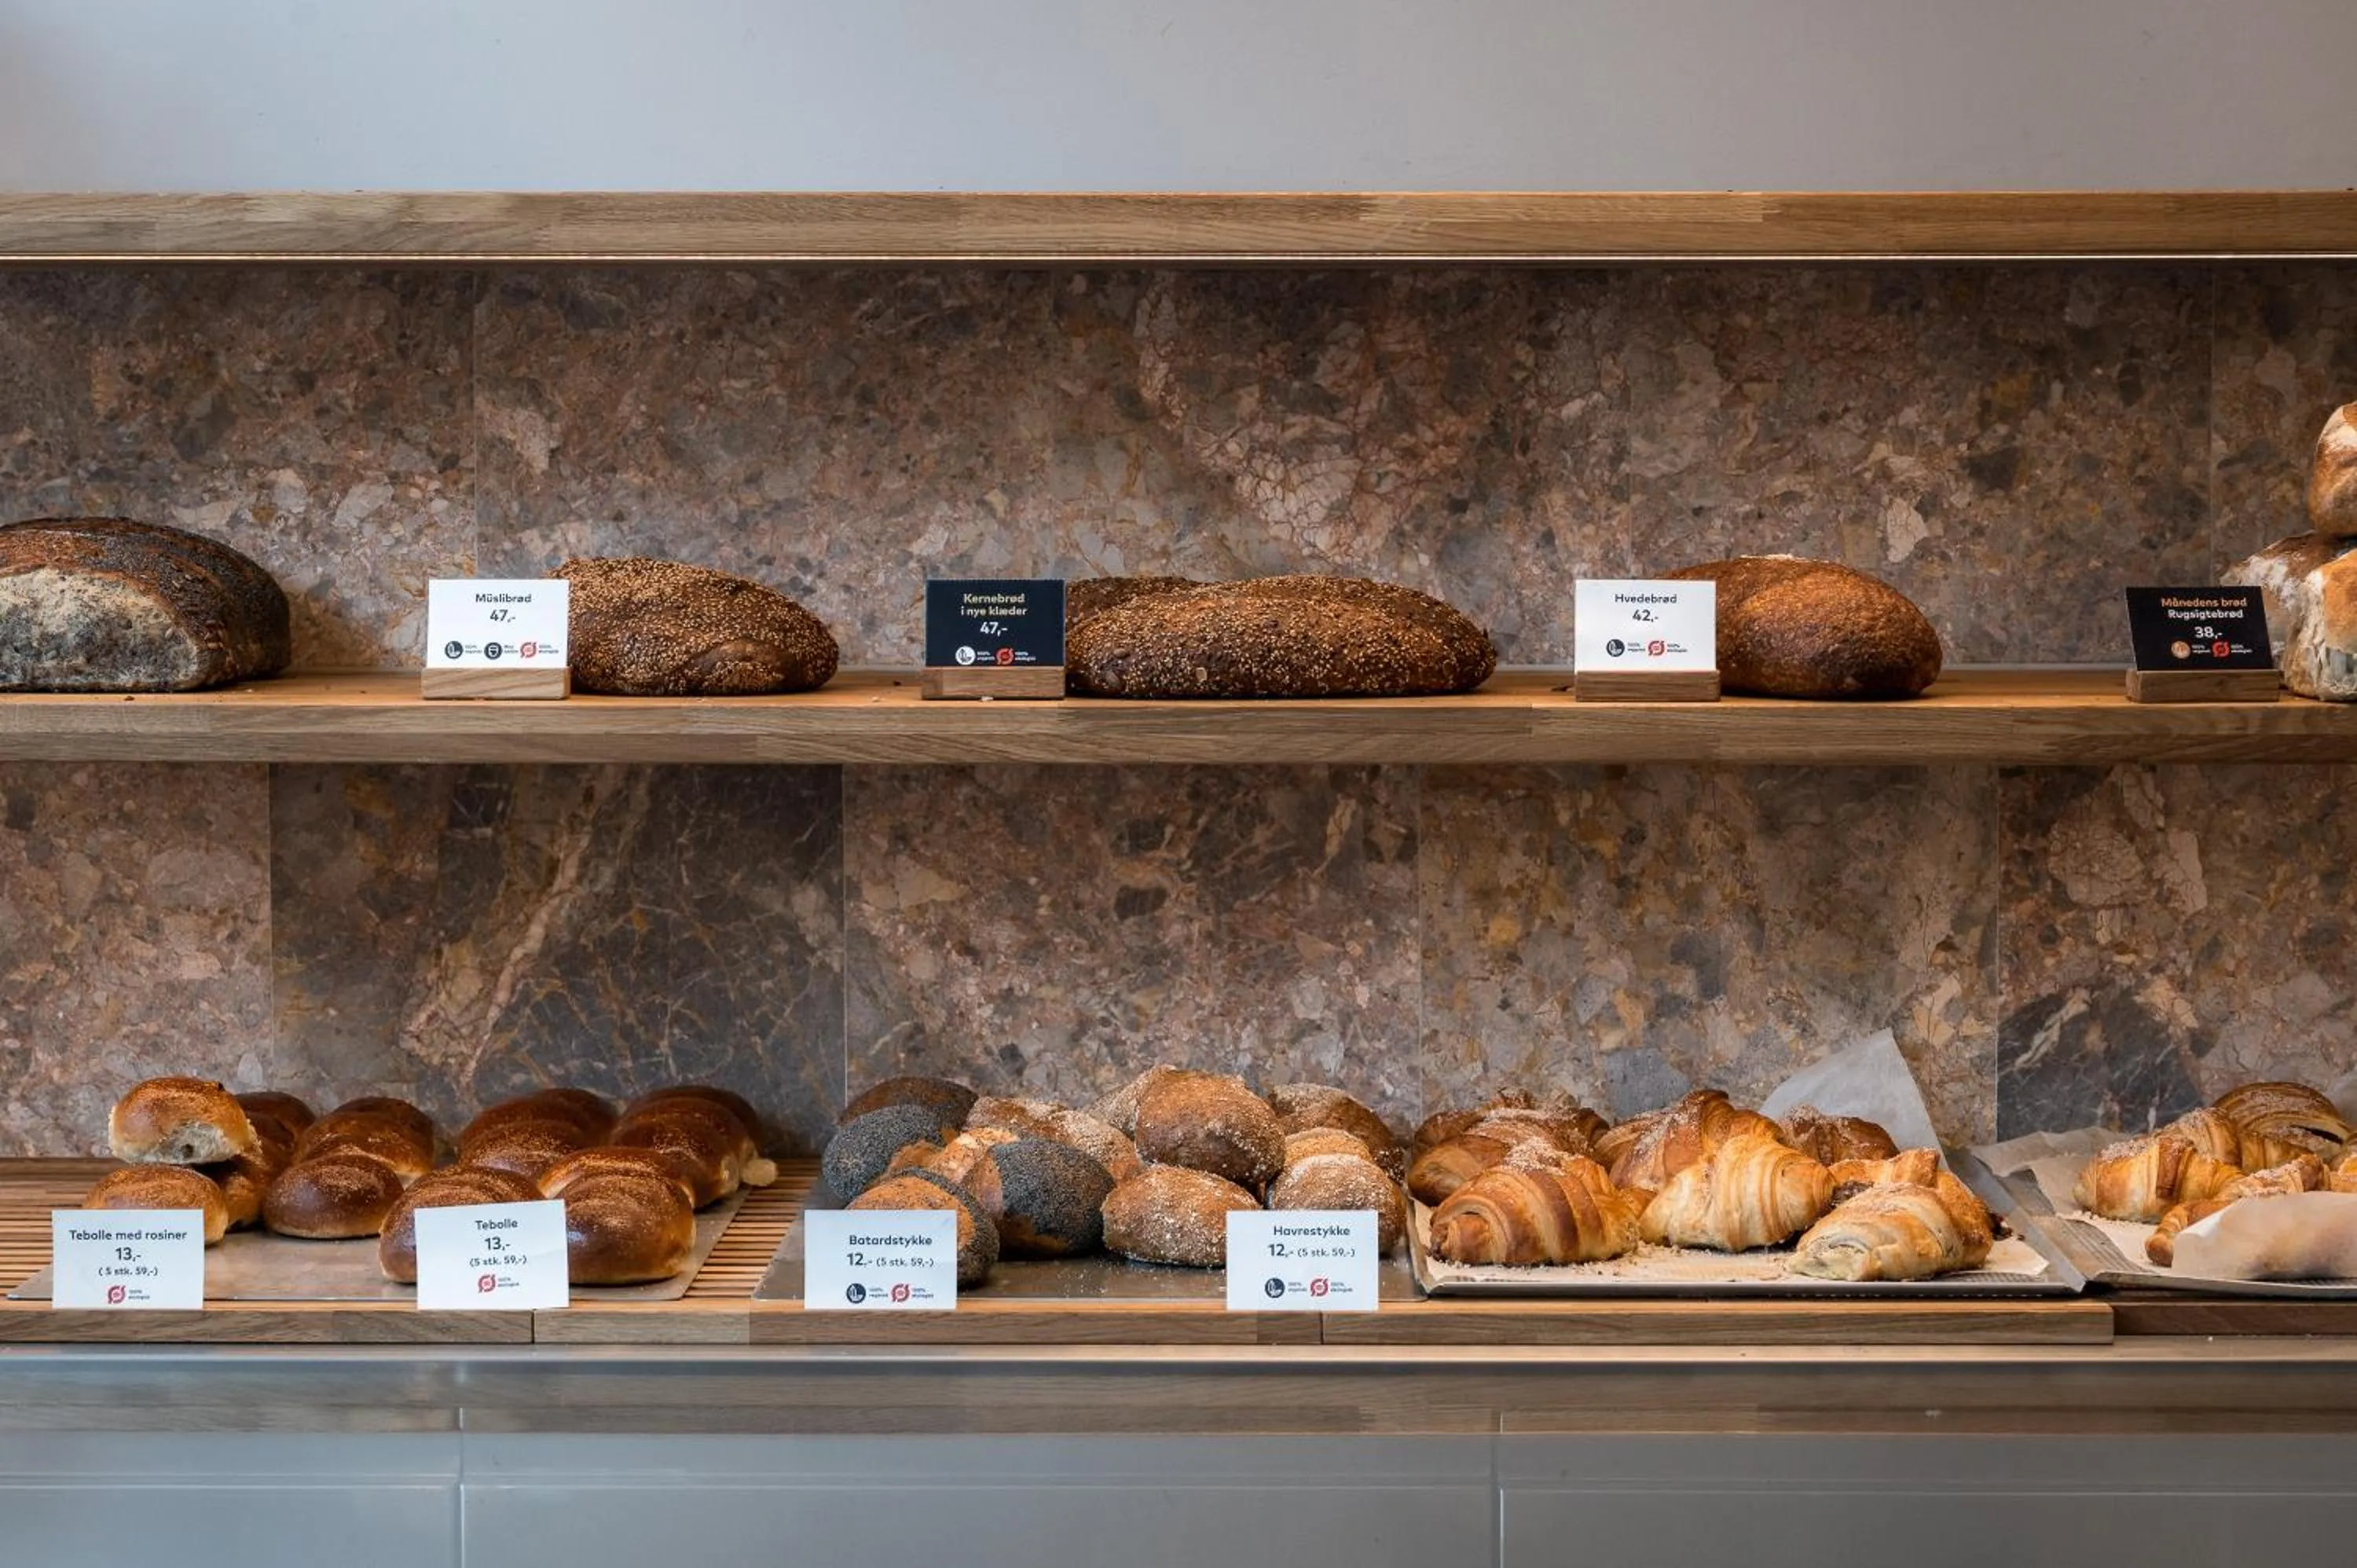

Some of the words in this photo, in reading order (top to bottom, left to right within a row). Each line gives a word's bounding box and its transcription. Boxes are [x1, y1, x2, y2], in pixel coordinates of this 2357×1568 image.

[2161, 597, 2219, 606] Månedens
[2221, 598, 2247, 606] brød
[961, 606, 964, 615] i
[966, 609, 986, 618] nye
[988, 606, 1027, 615] klæder
[2168, 610, 2243, 621] Rugsigtebrød
[475, 1219, 518, 1230] Tebolle
[69, 1229, 112, 1240] Tebolle
[115, 1230, 141, 1240] med
[145, 1229, 187, 1240] rosiner
[1274, 1225, 1350, 1238] Havrestykke
[849, 1235, 932, 1247] Batardstykke
